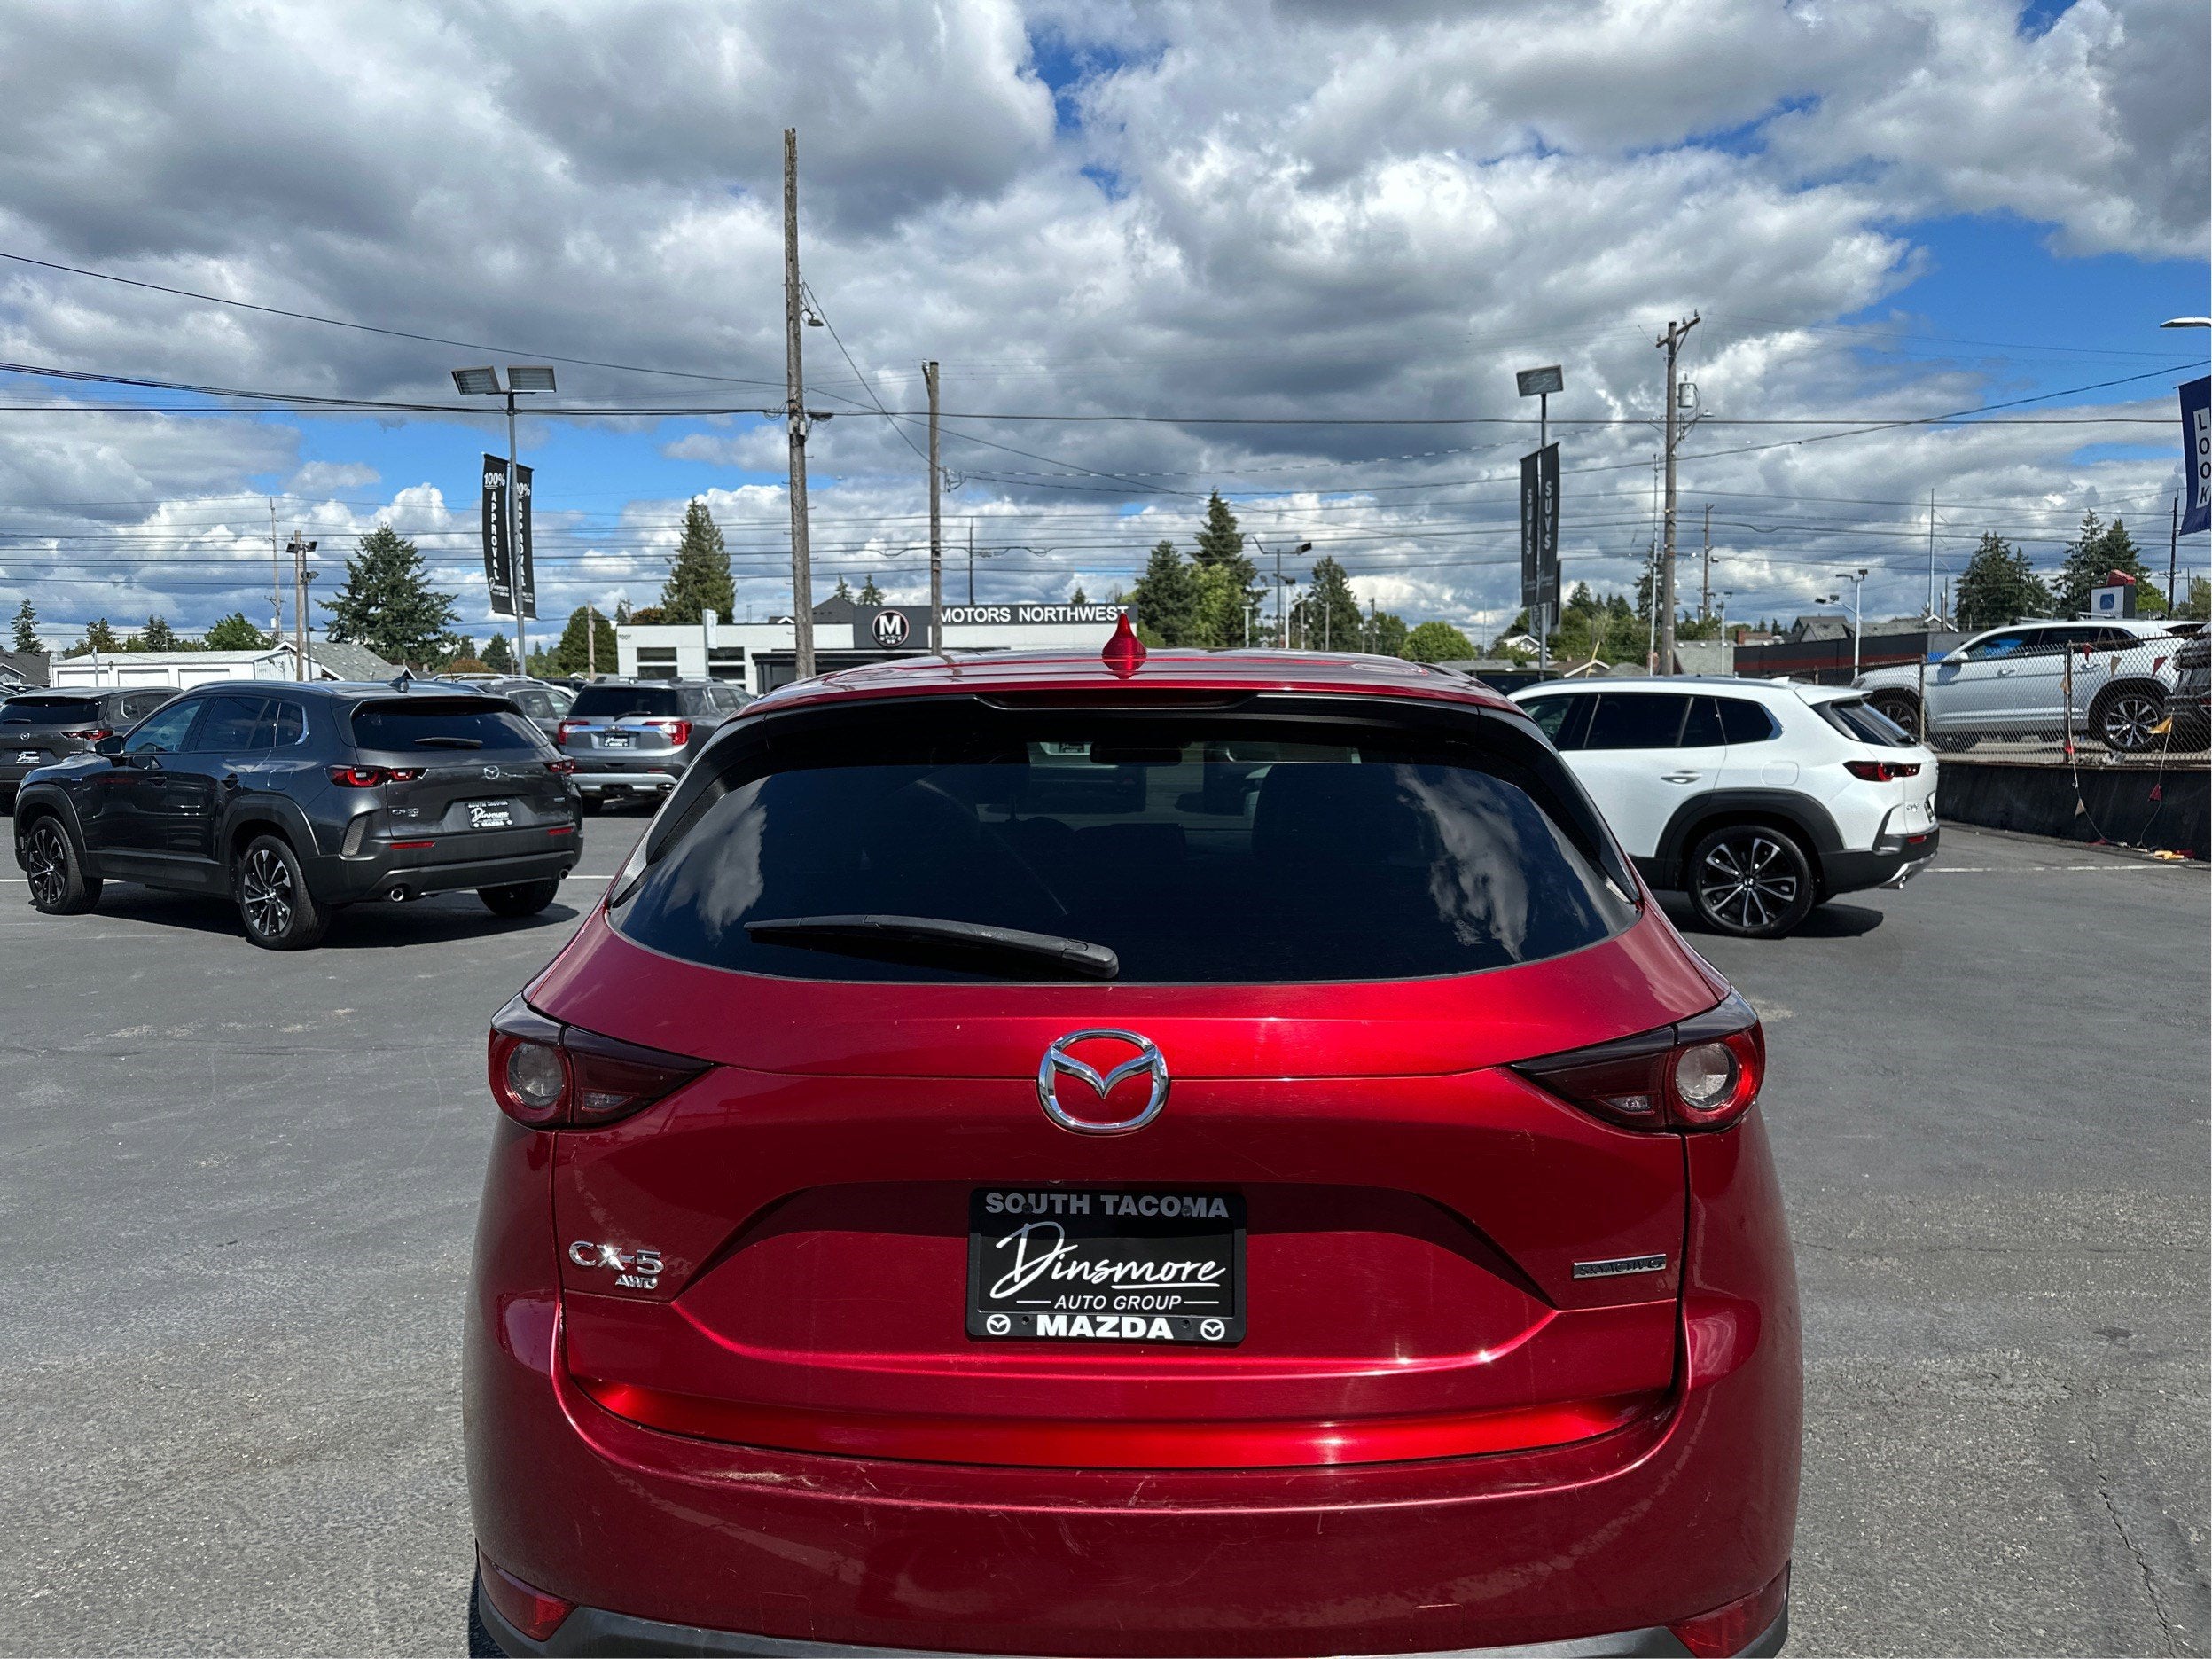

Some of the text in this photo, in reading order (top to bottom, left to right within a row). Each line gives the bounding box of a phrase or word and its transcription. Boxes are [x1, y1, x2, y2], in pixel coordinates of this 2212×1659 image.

[2198, 413, 2211, 504] LOOK
[484, 472, 505, 487] 100%
[517, 482, 531, 497] 0%
[490, 491, 500, 580] APPROVAL
[879, 614, 901, 636] M
[941, 605, 1129, 622] MOTORS NORTHWEST
[986, 1193, 1230, 1218] SOUTH TACOMA
[568, 1240, 664, 1275] CX-5
[989, 1221, 1226, 1299] Dinsmore
[614, 1274, 658, 1290] AWD
[1054, 1295, 1181, 1311] AUTO GROUP
[1036, 1314, 1174, 1340] MAZDA
